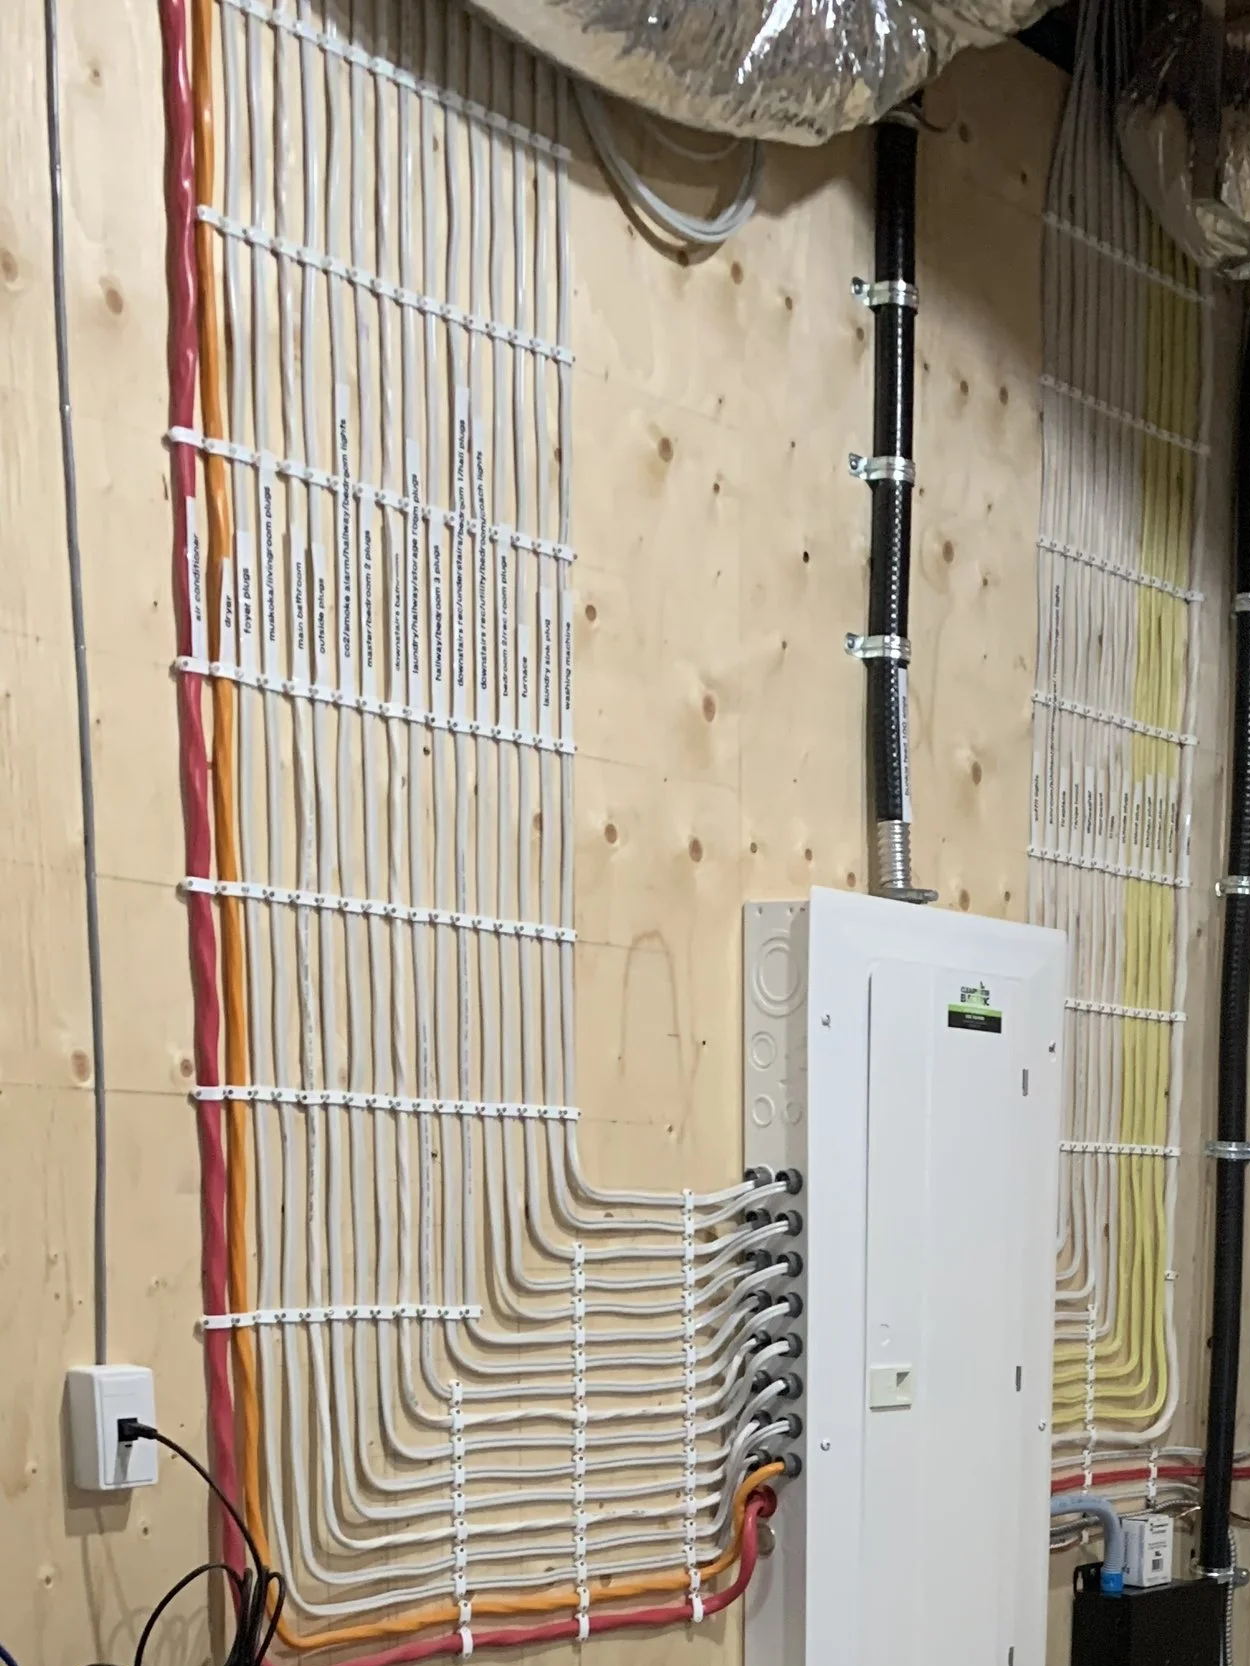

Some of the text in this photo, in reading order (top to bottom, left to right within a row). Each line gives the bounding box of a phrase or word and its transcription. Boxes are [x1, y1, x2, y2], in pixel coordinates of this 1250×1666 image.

[339, 419, 348, 451] lights
[457, 420, 466, 450] plugs
[457, 452, 465, 482] 1/hall
[475, 451, 484, 481] lights
[263, 486, 272, 518] plugs
[364, 531, 372, 560] plugs
[432, 545, 442, 574] plugs
[192, 534, 201, 602] conditioner
[410, 474, 420, 674] laundry/hallway/storage room plugs
[500, 556, 508, 584] plugs
[241, 568, 251, 634] foyer plugs
[295, 562, 303, 619] bathroom
[224, 596, 232, 628] dryer
[317, 578, 325, 654] outside plugs
[343, 596, 351, 658] co2/smoke
[364, 574, 374, 667] master/bedroom
[501, 617, 509, 646] 2/rec
[434, 587, 443, 681] hallway/bedroom
[456, 628, 464, 687] downstairs
[478, 632, 487, 689] downstairs
[543, 668, 552, 707] laundry
